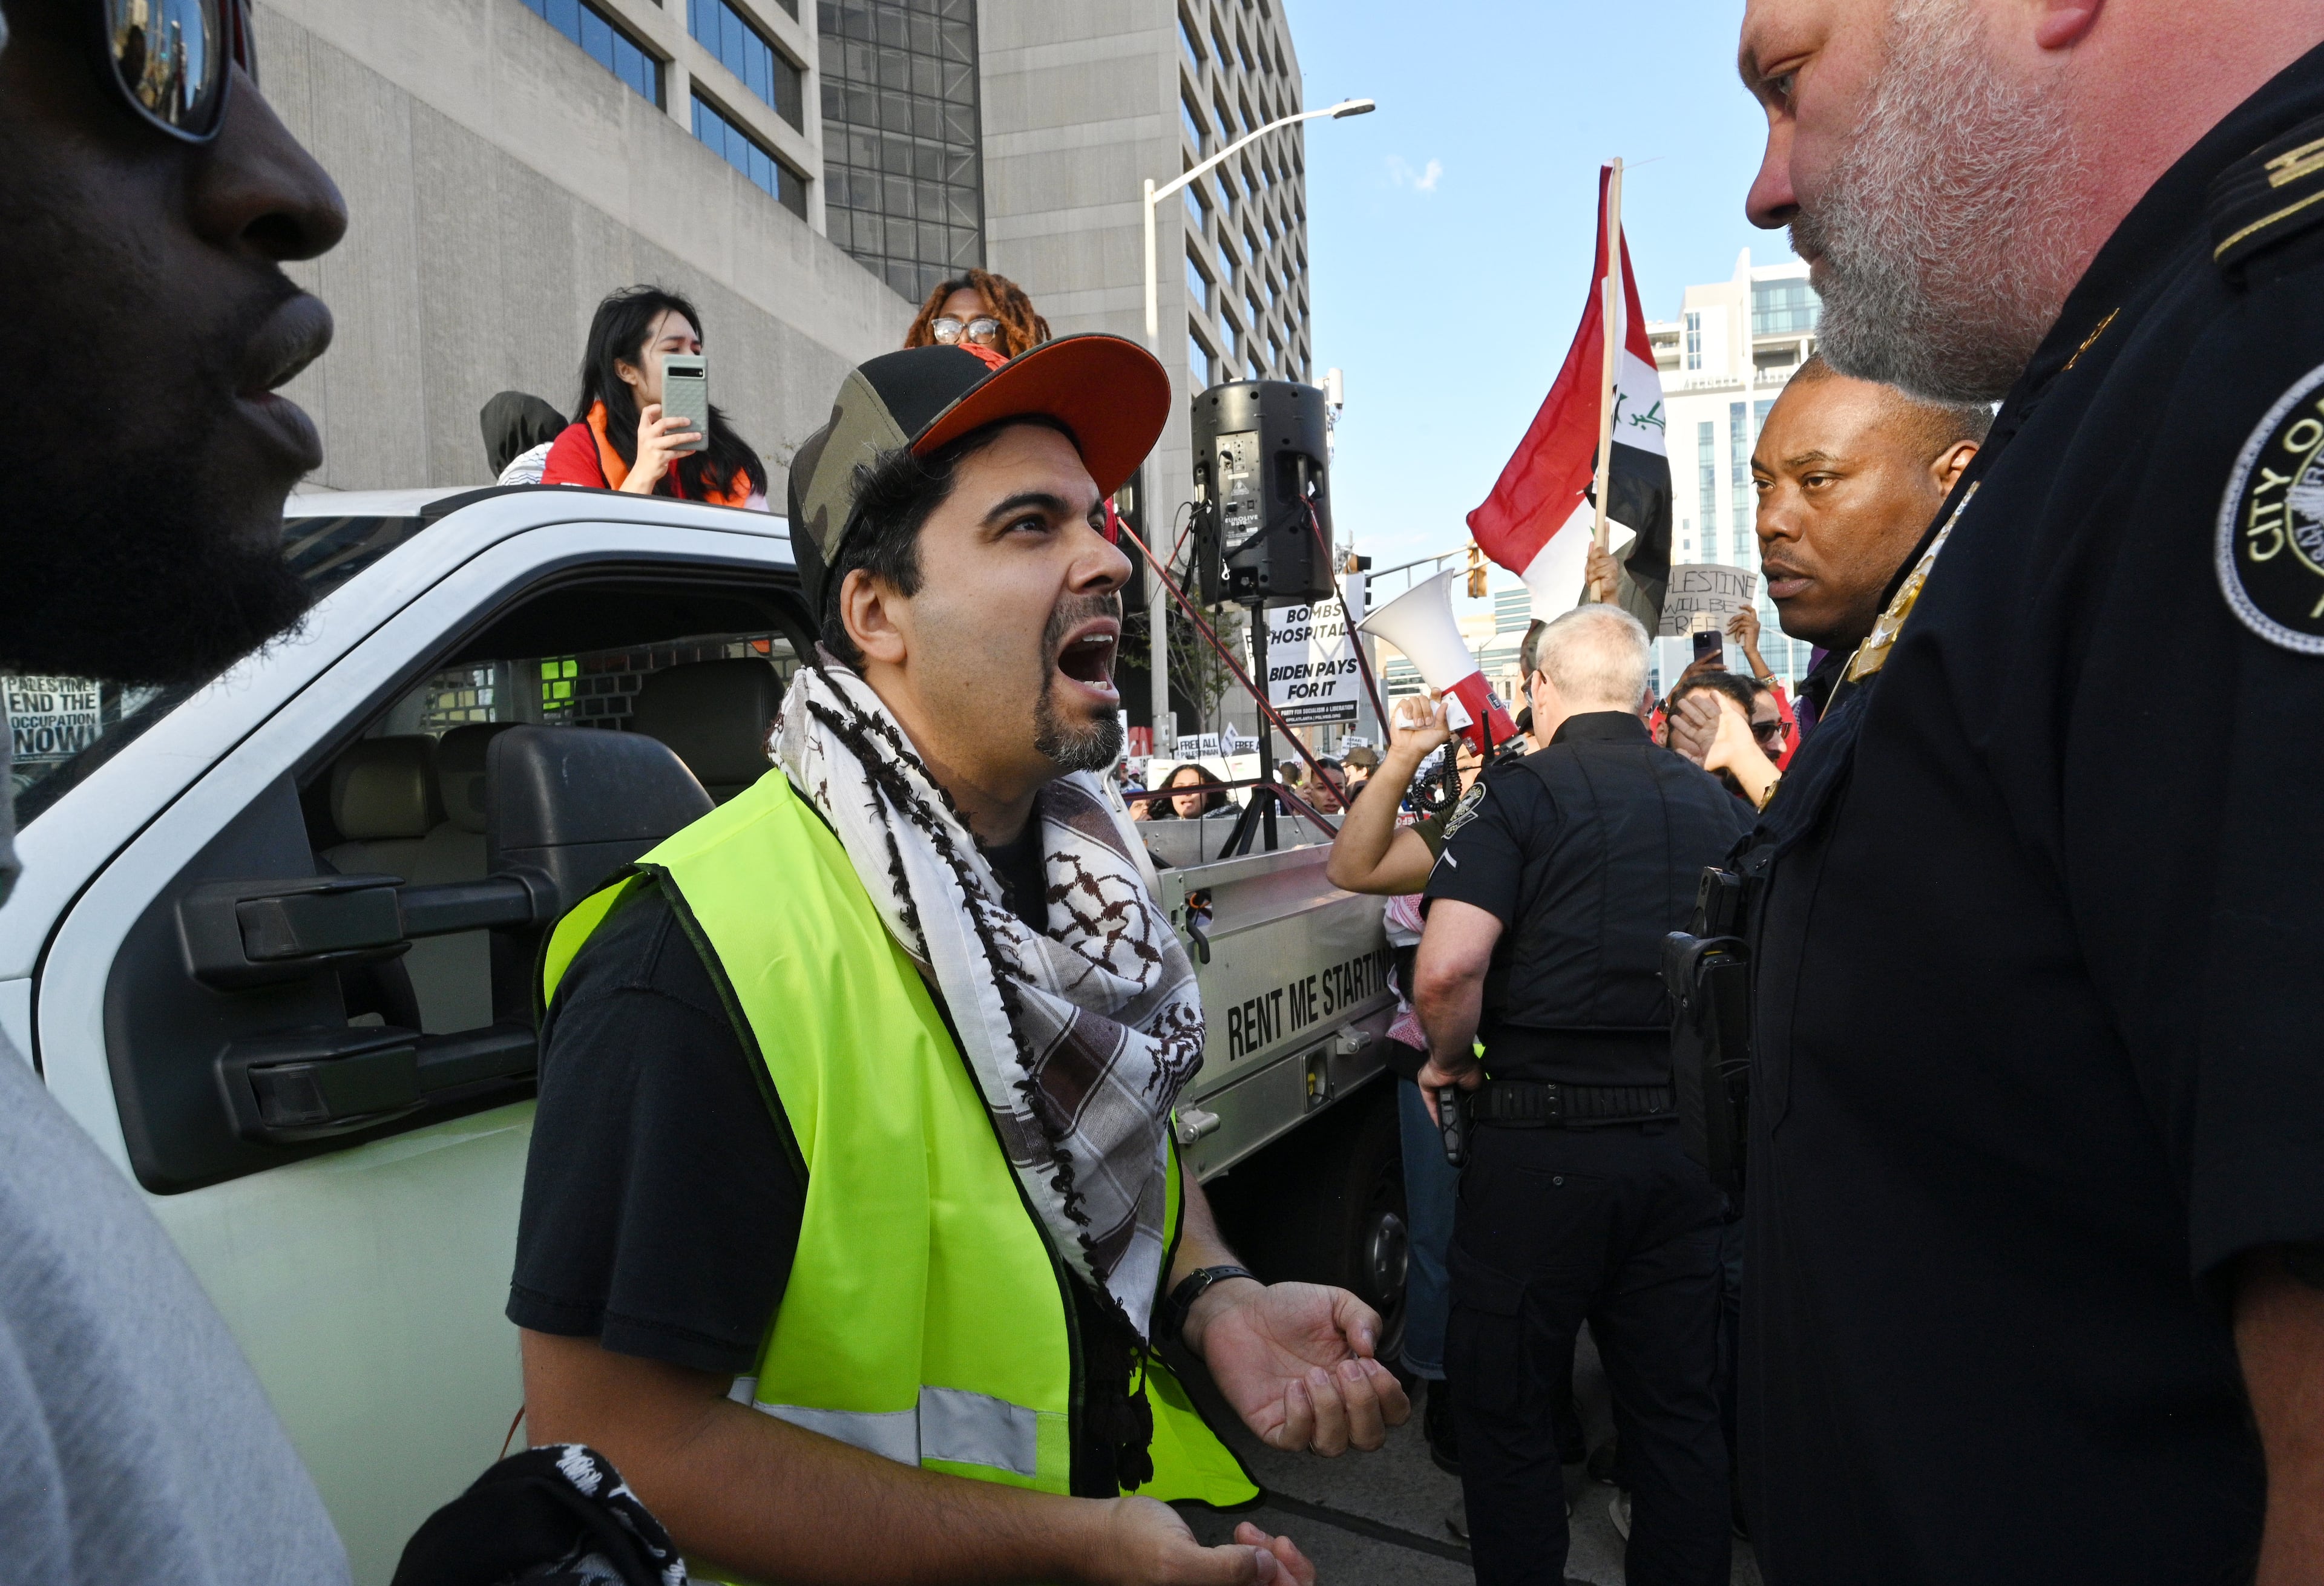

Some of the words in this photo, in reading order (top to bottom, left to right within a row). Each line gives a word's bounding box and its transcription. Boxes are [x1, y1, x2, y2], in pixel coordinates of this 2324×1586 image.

[1224, 514, 1258, 523] EUROLIVE
[2247, 467, 2291, 562] CITY
[1286, 605, 1342, 623] BOMBS
[1664, 597, 1704, 615] WILL
[1709, 598, 1737, 613] BE
[1269, 663, 1313, 682] BIDEN
[1316, 658, 1357, 677] PAYS
[1287, 683, 1319, 700] FOR
[1321, 680, 1337, 696] IT
[9, 692, 54, 713] END
[59, 692, 96, 711] THE
[1330, 704, 1354, 712] LIBERATION
[11, 713, 96, 729] OCCUPATION
[1180, 740, 1199, 750] FREE
[1203, 738, 1218, 748] ALL
[1227, 988, 1283, 1062] RENT
[1288, 974, 1319, 1032] ME
[1322, 948, 1389, 1016] STARTIN
